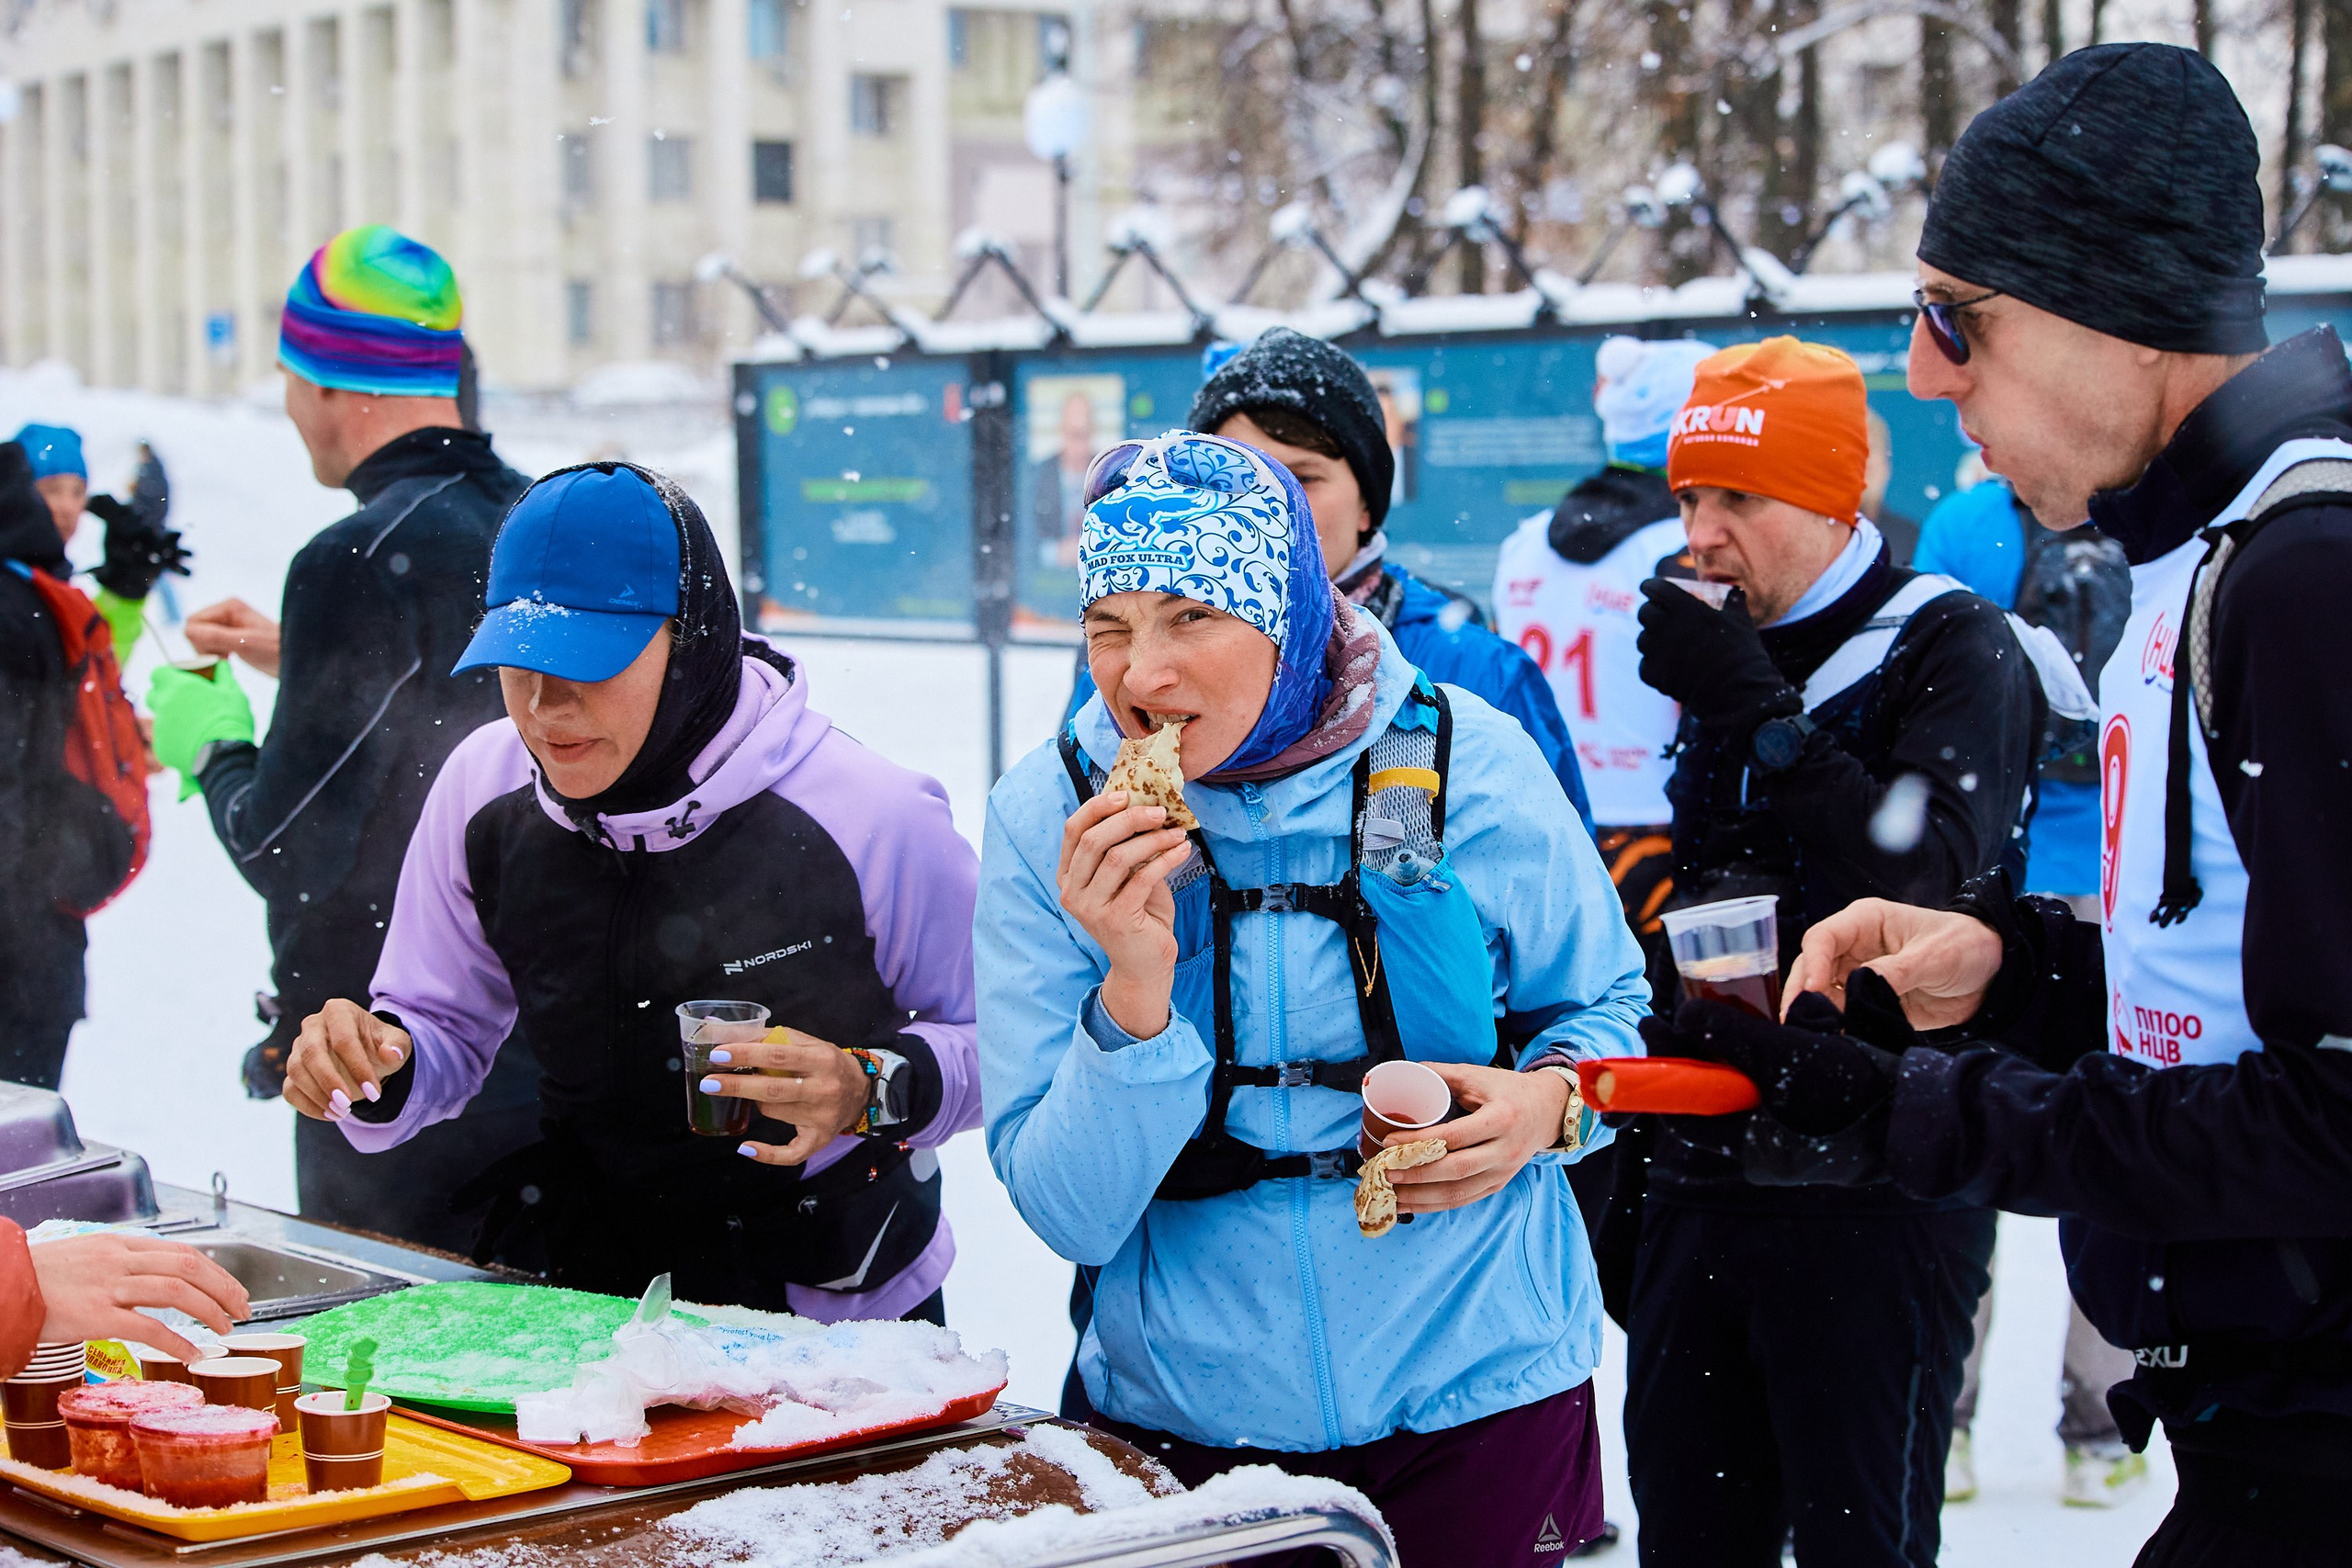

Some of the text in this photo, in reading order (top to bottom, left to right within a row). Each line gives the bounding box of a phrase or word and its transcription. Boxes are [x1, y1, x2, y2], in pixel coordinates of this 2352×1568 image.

[1087, 553, 1184, 571] MAD FOX ULTRA
[743, 940, 813, 968] NORDSKI
[1533, 1540, 1565, 1553] Reebok
